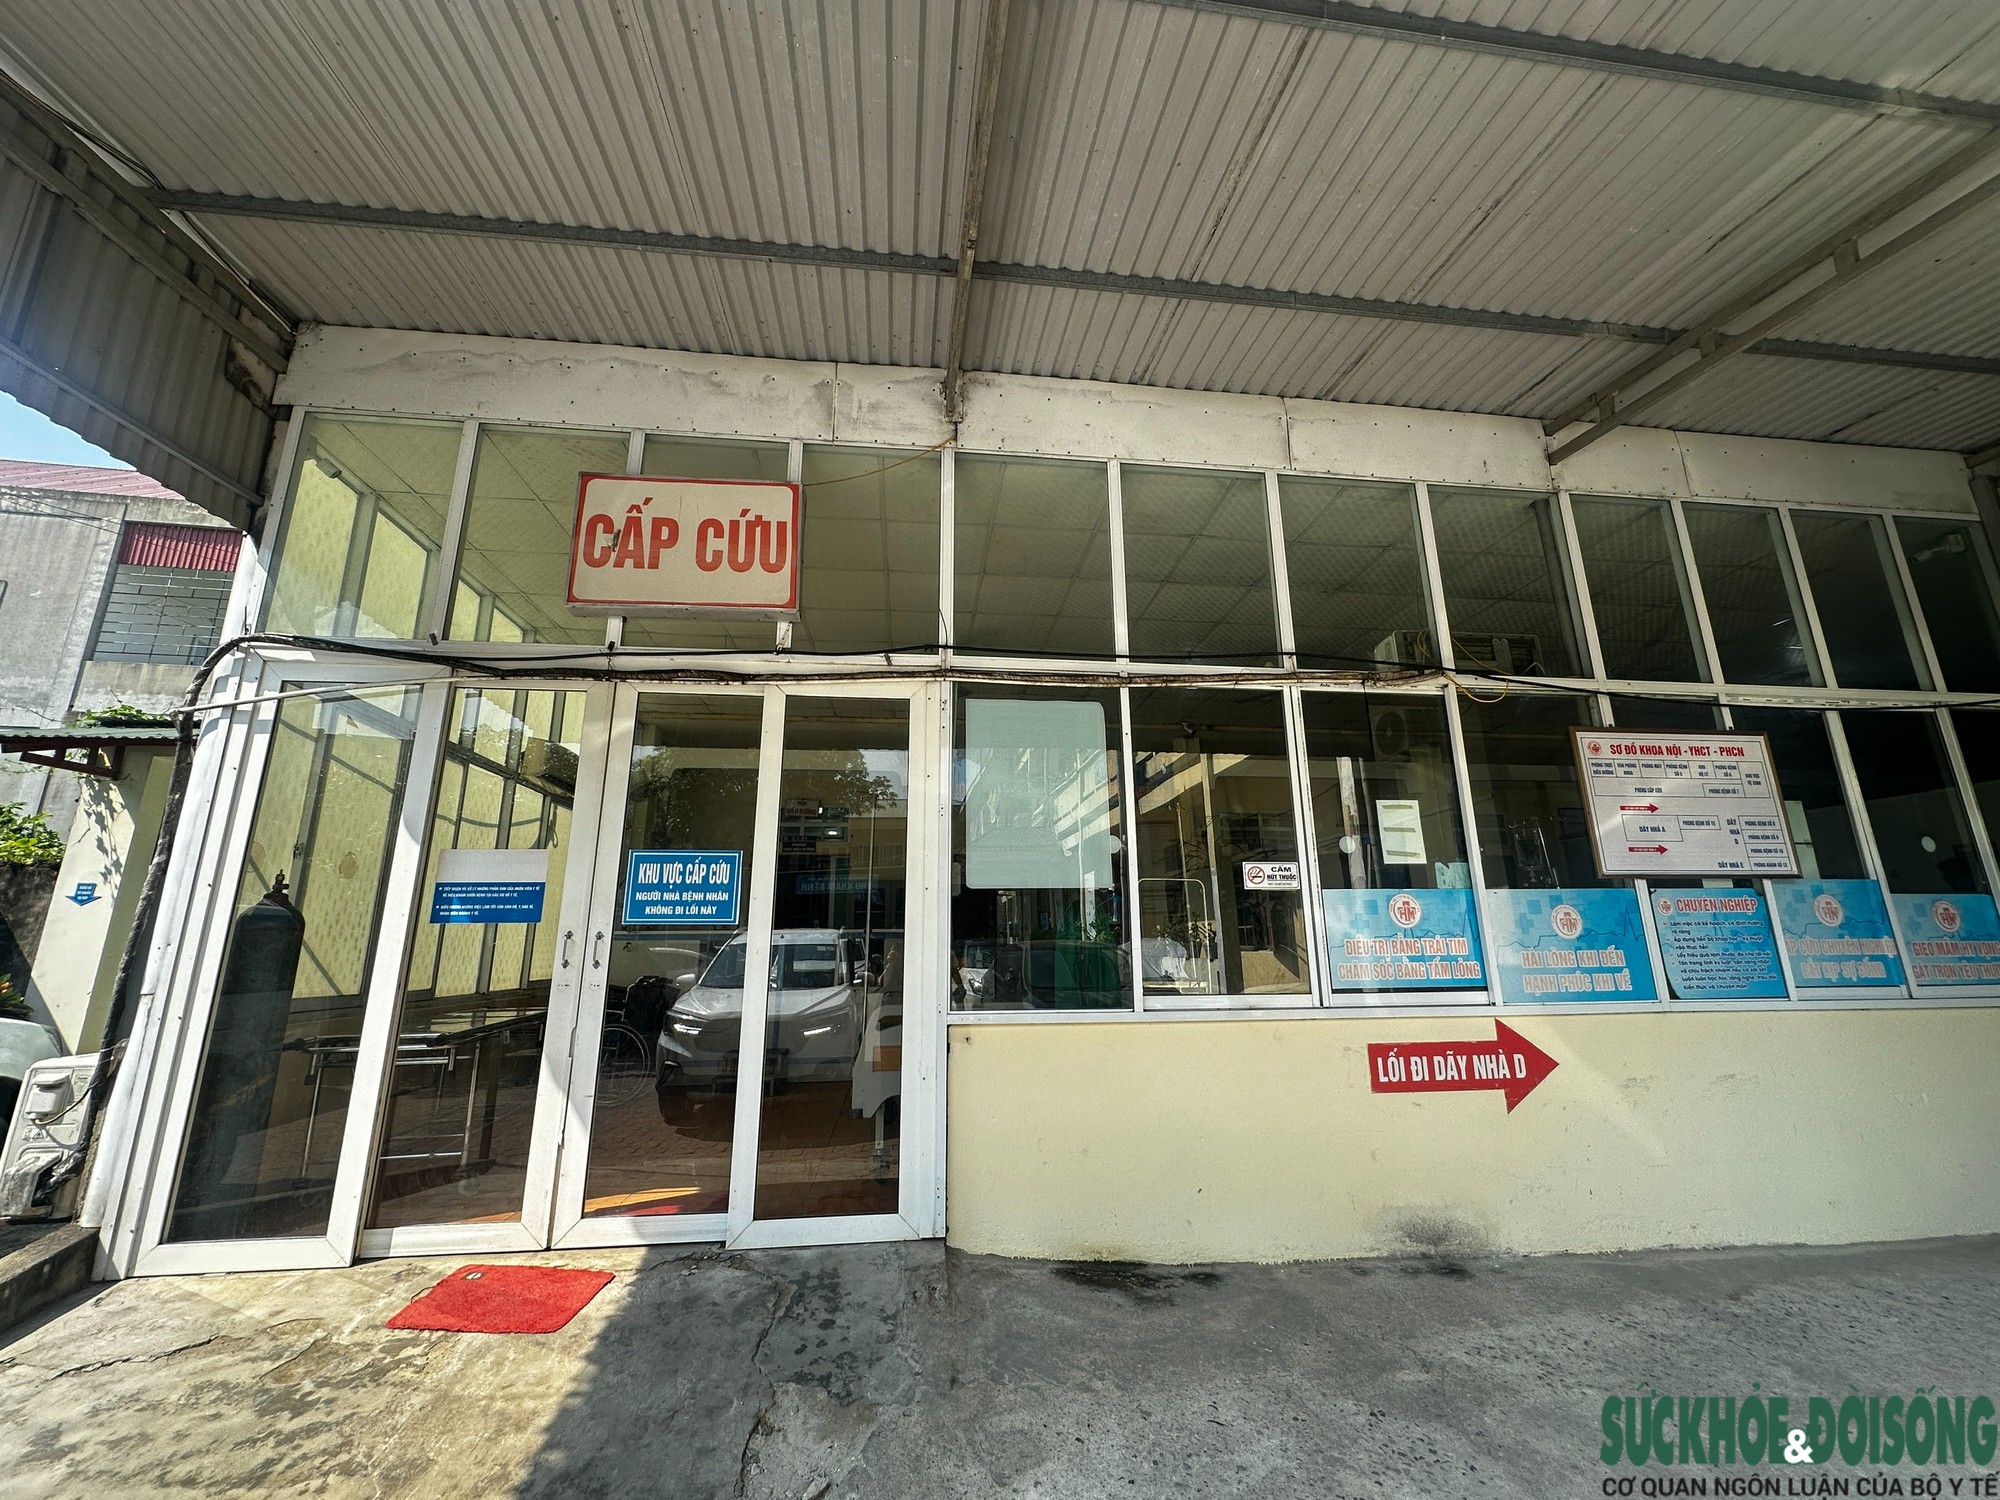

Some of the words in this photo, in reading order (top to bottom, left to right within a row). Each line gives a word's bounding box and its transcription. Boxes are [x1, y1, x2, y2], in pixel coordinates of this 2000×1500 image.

[583, 497, 679, 570] CẤP
[696, 508, 787, 573] CỨU
[1610, 744, 1622, 755] SƠ
[1625, 742, 1637, 755] ĐỒ
[1639, 745, 1664, 756] KHOA
[1665, 744, 1682, 758] NỘI
[1719, 747, 1745, 757] PHCN
[638, 863, 660, 884] KHU
[663, 861, 683, 889] VỰC
[686, 857, 707, 885] CẤP
[709, 859, 731, 885] CỨU
[1271, 864, 1292, 873] CẤM
[636, 890, 661, 901] NGƯỜI
[663, 890, 680, 901] NHÀ
[682, 890, 704, 903] BỆNH
[706, 891, 729, 901] NHÂN
[1676, 896, 1718, 912] CHUYÊN
[1721, 896, 1757, 915] NGHIỆP
[645, 904, 673, 915] KHÔNG
[675, 906, 684, 915] ĐI
[686, 903, 699, 915] LỐI
[701, 904, 717, 915] NÀY
[1345, 935, 1370, 955] ĐIỀU
[1372, 941, 1390, 958] TRỊ
[1392, 934, 1420, 955] BẰNG
[1422, 936, 1446, 955] TRÁI
[1448, 939, 1468, 954] TIM
[1522, 948, 1542, 967] HÀI
[1544, 948, 1576, 967] LÒNG
[1578, 951, 1599, 966] KHI
[1600, 946, 1625, 966] ĐẾN
[1912, 942, 1935, 956] GIEO
[1936, 937, 1961, 956] MẦM
[1961, 942, 1975, 956] HY
[1338, 961, 1370, 979] CHĂM
[1372, 960, 1394, 979] SÓC
[1396, 957, 1426, 979] BẰNG
[1428, 957, 1452, 978] TẤM
[1453, 958, 1480, 978] LÒNG
[1524, 975, 1557, 995] HẠNH
[1559, 972, 1592, 991] PHÚC
[1594, 975, 1614, 991] KHI
[1616, 969, 1632, 990] VỀ
[1377, 1048, 1406, 1083] LỐI
[1410, 1056, 1430, 1082] ĐI
[1434, 1051, 1467, 1081] DÃY
[1473, 1049, 1511, 1080] NHÀ
[1513, 1054, 1527, 1079] D
